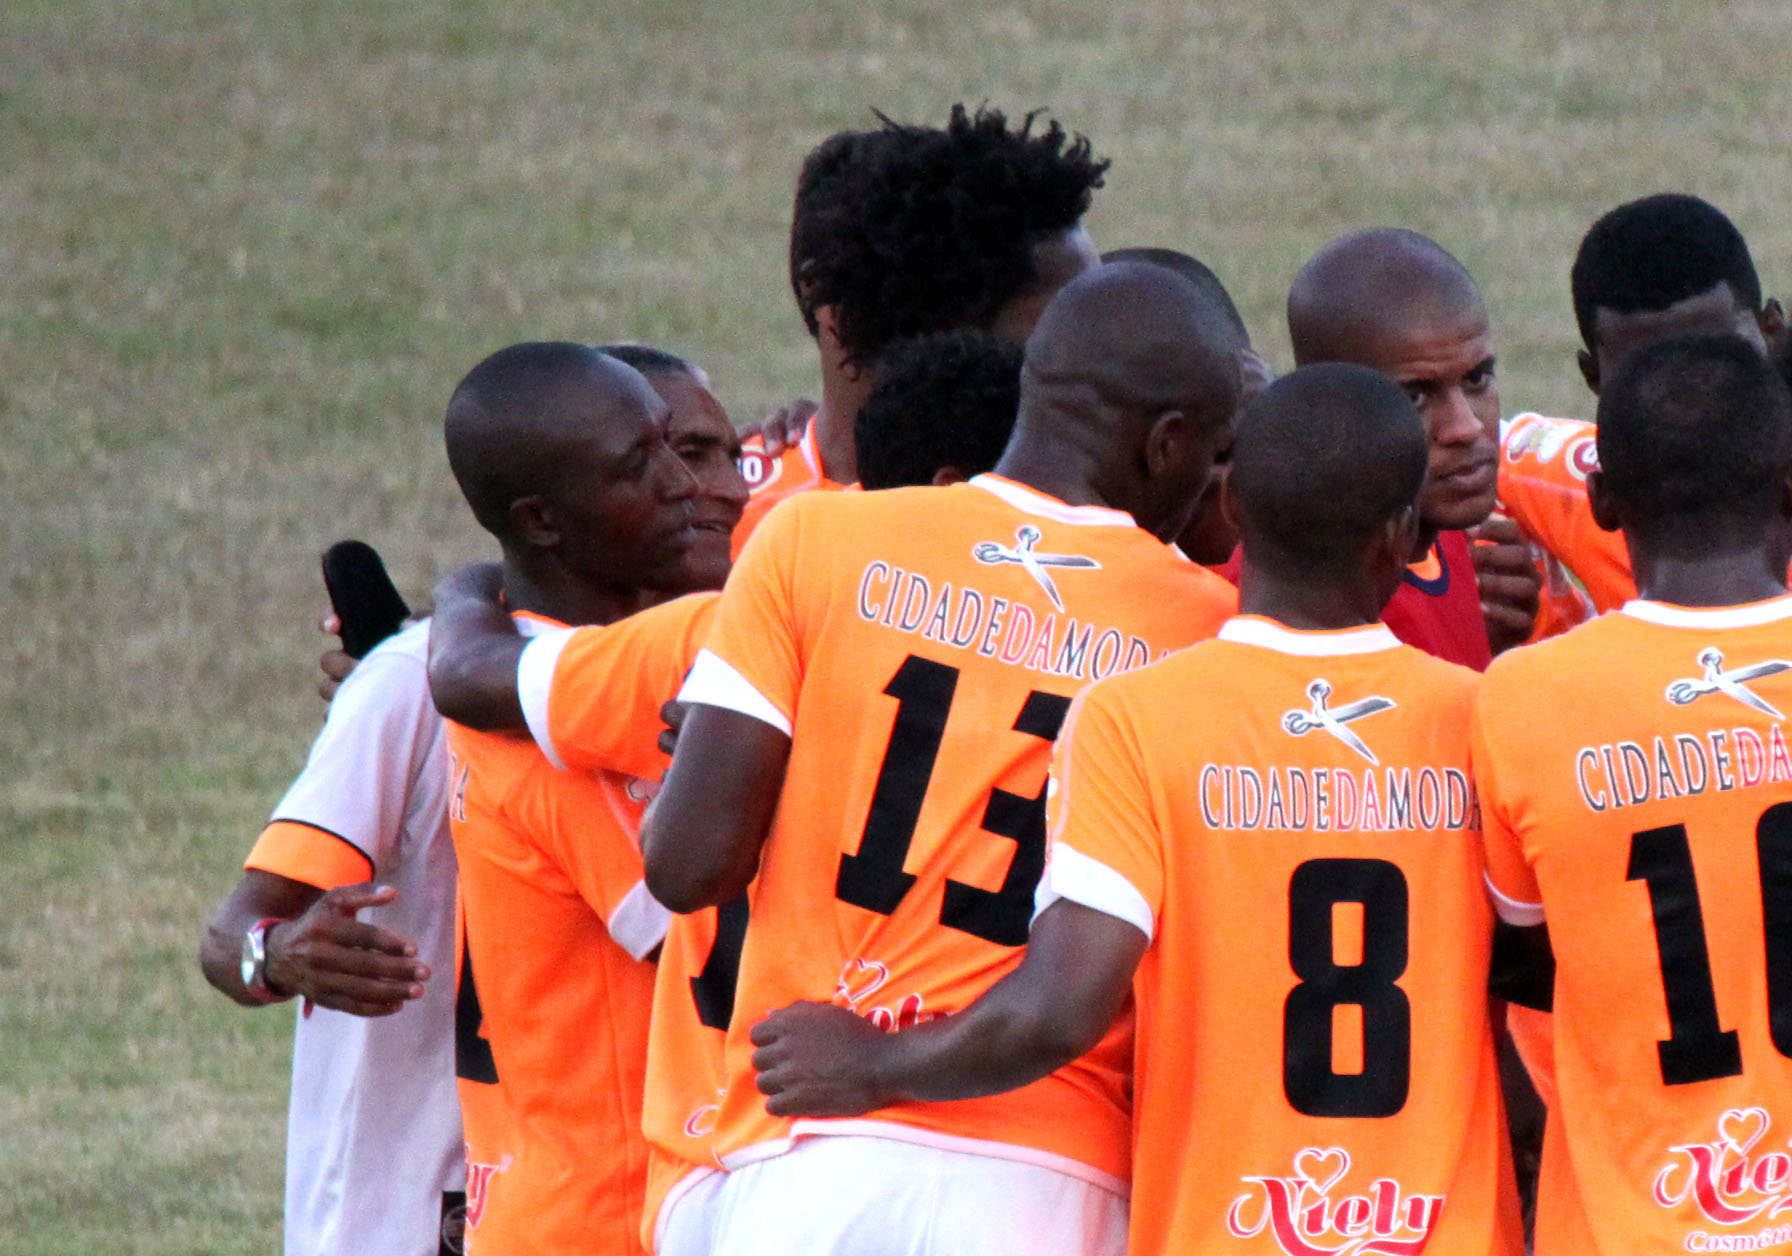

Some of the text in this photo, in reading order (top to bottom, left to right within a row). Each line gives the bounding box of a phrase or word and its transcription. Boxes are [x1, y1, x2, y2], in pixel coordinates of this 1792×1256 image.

[858, 560, 1169, 680] CIDADEDAMOD
[836, 653, 1074, 947] 13
[1283, 857, 1411, 1118] 8
